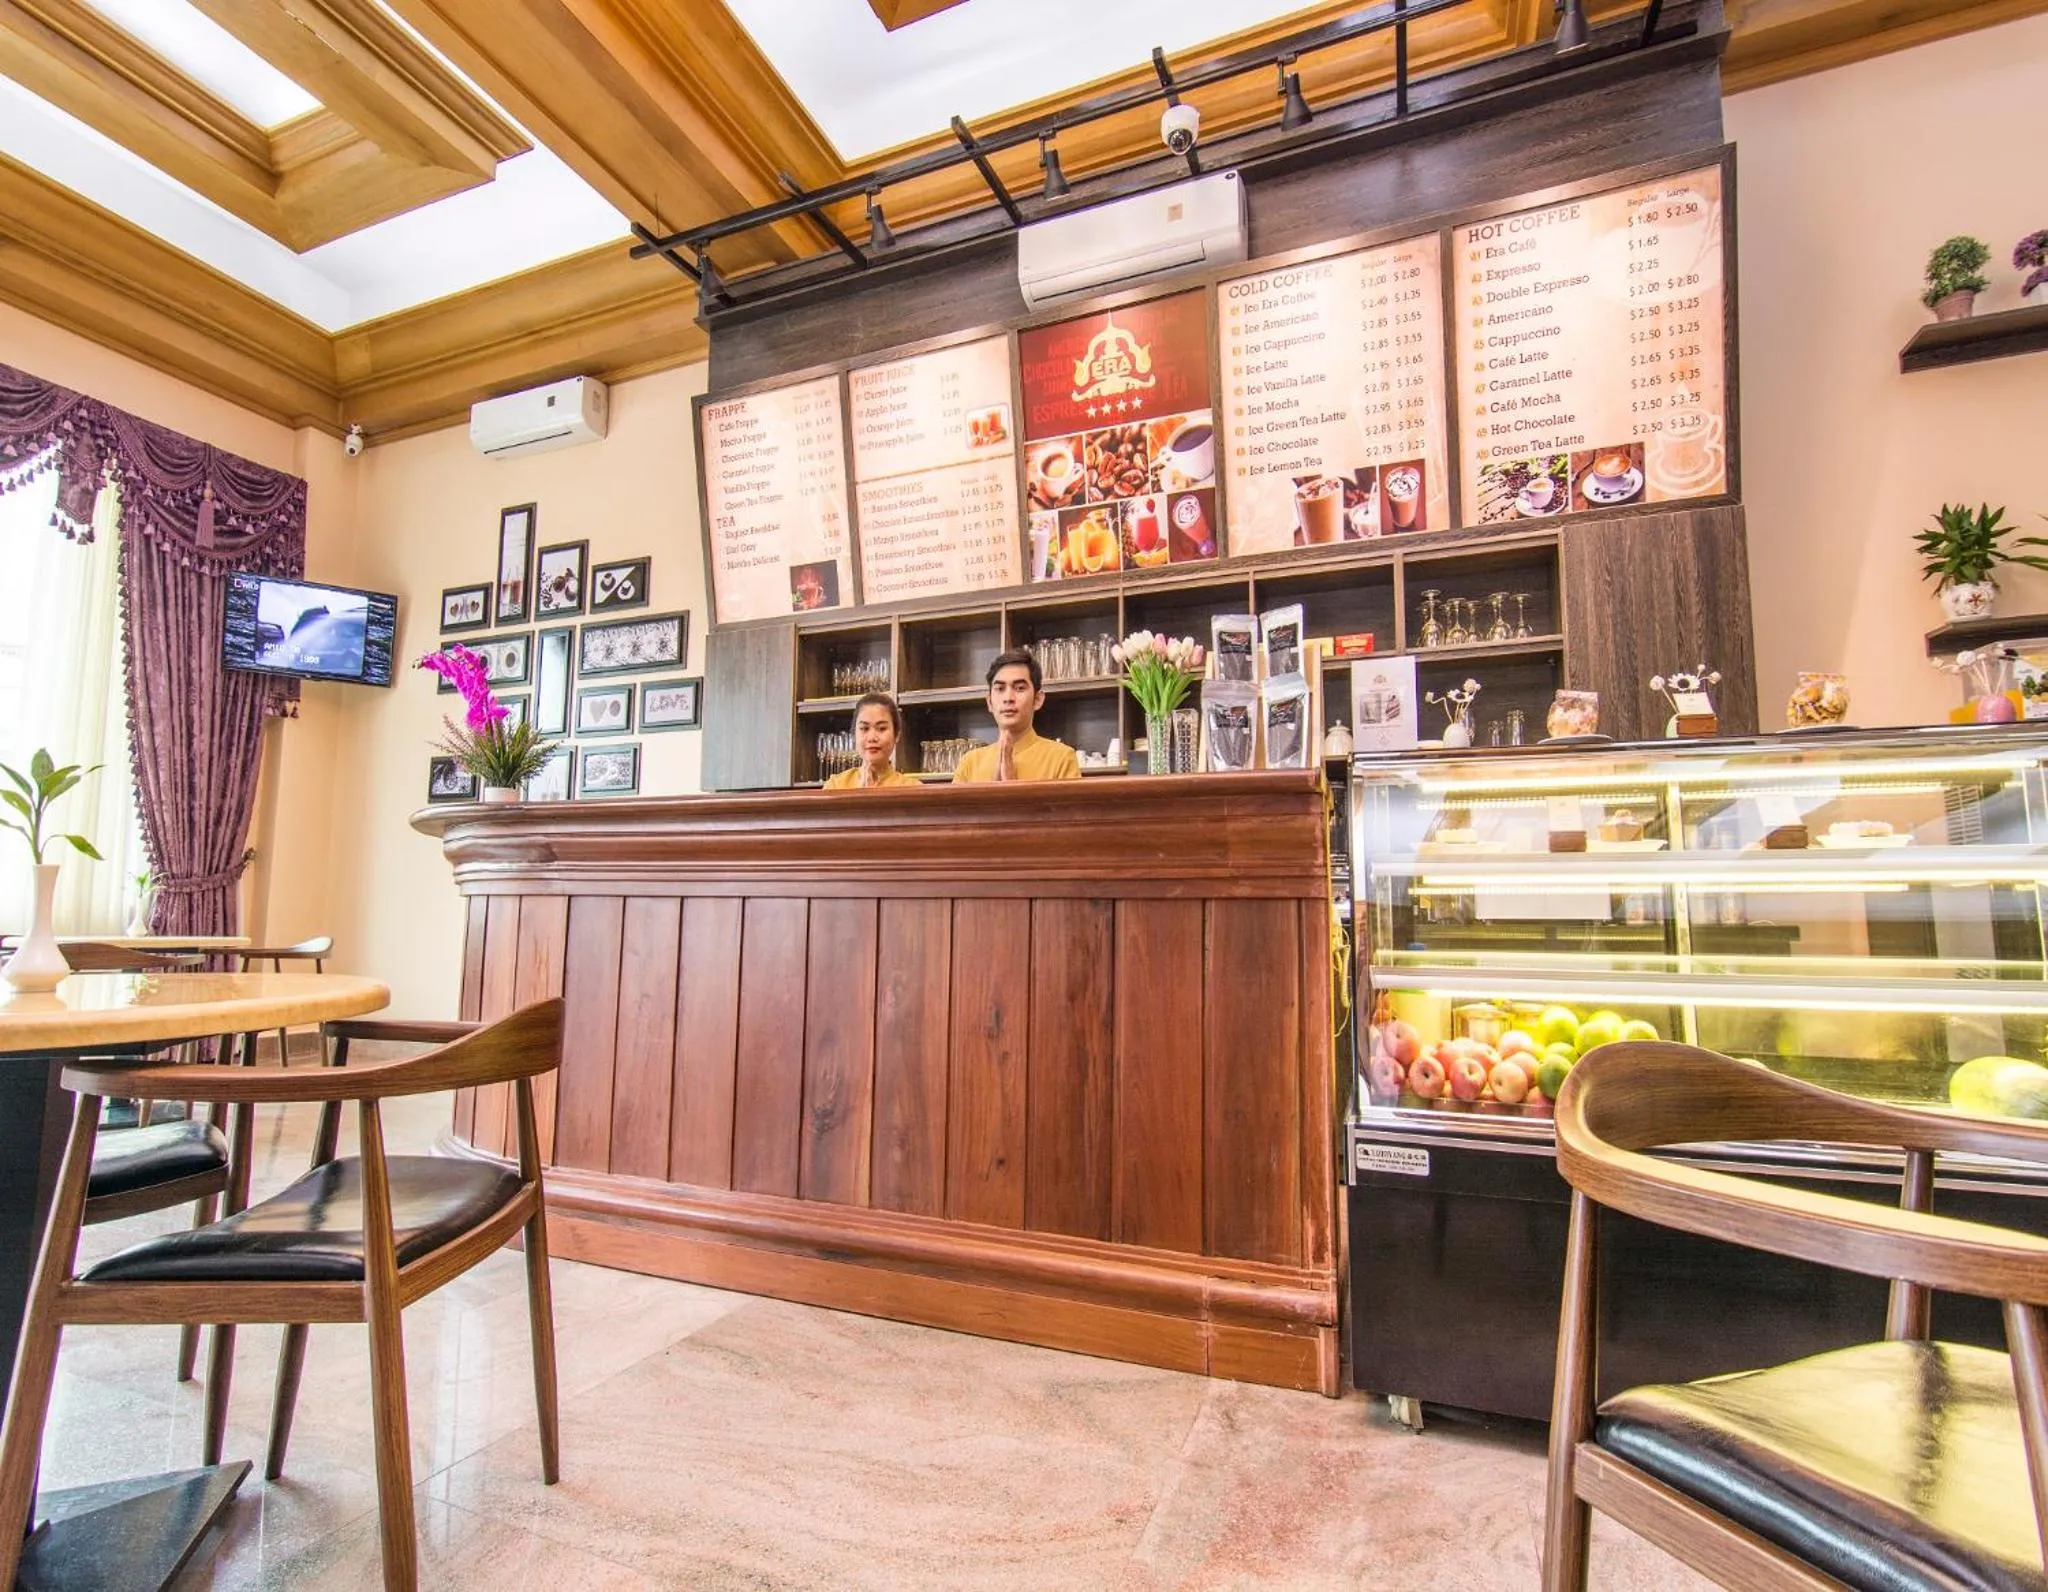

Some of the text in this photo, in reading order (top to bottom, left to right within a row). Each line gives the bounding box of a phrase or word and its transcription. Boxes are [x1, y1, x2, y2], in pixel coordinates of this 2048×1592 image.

[1468, 204, 1580, 244] HOT COFFEE
[1485, 246, 1506, 259] Era
[1228, 265, 1333, 299] COLD COFFEE
[1486, 262, 1541, 281] Expresso
[1486, 287, 1530, 304] Double
[1533, 274, 1590, 294] Expresso
[1262, 299, 1279, 310] Era
[1487, 305, 1553, 325] Americano
[1244, 311, 1319, 335] Ice Americano
[1245, 344, 1261, 355] Ice
[1263, 331, 1325, 351] Cappuccino
[1488, 326, 1561, 347] Cappuccino
[1091, 355, 1133, 377] ERA
[1246, 364, 1262, 375] Ice
[1263, 359, 1288, 371] Latte
[1488, 355, 1516, 370] Café
[1519, 351, 1549, 364] Latte
[1247, 385, 1262, 395] Ice
[1263, 378, 1298, 391] Vanilla
[1300, 373, 1326, 386] Latte
[1489, 373, 1540, 392] Caramel
[1543, 369, 1573, 382] Latte
[708, 402, 748, 420] FRAPPE
[1248, 404, 1263, 415] Ice
[1264, 398, 1299, 412] Mocha
[1520, 393, 1561, 408] Mocha
[1248, 425, 1264, 436] Ice
[1266, 419, 1298, 433] Green
[1299, 415, 1319, 427] Tea
[1320, 411, 1347, 423] Latte
[1490, 424, 1511, 435] Hot
[1513, 414, 1575, 431] Chocolate
[1249, 445, 1265, 456] Ice
[1266, 437, 1319, 453] Chocolate
[1491, 443, 1528, 457] Green
[1530, 439, 1552, 452] Tea
[1555, 434, 1585, 447] Latte
[1249, 465, 1265, 476] Ice
[1267, 460, 1302, 473] Lemon
[1303, 456, 1323, 467] Tea
[862, 481, 924, 502] SMOOTHIES
[716, 516, 735, 529] TEA
